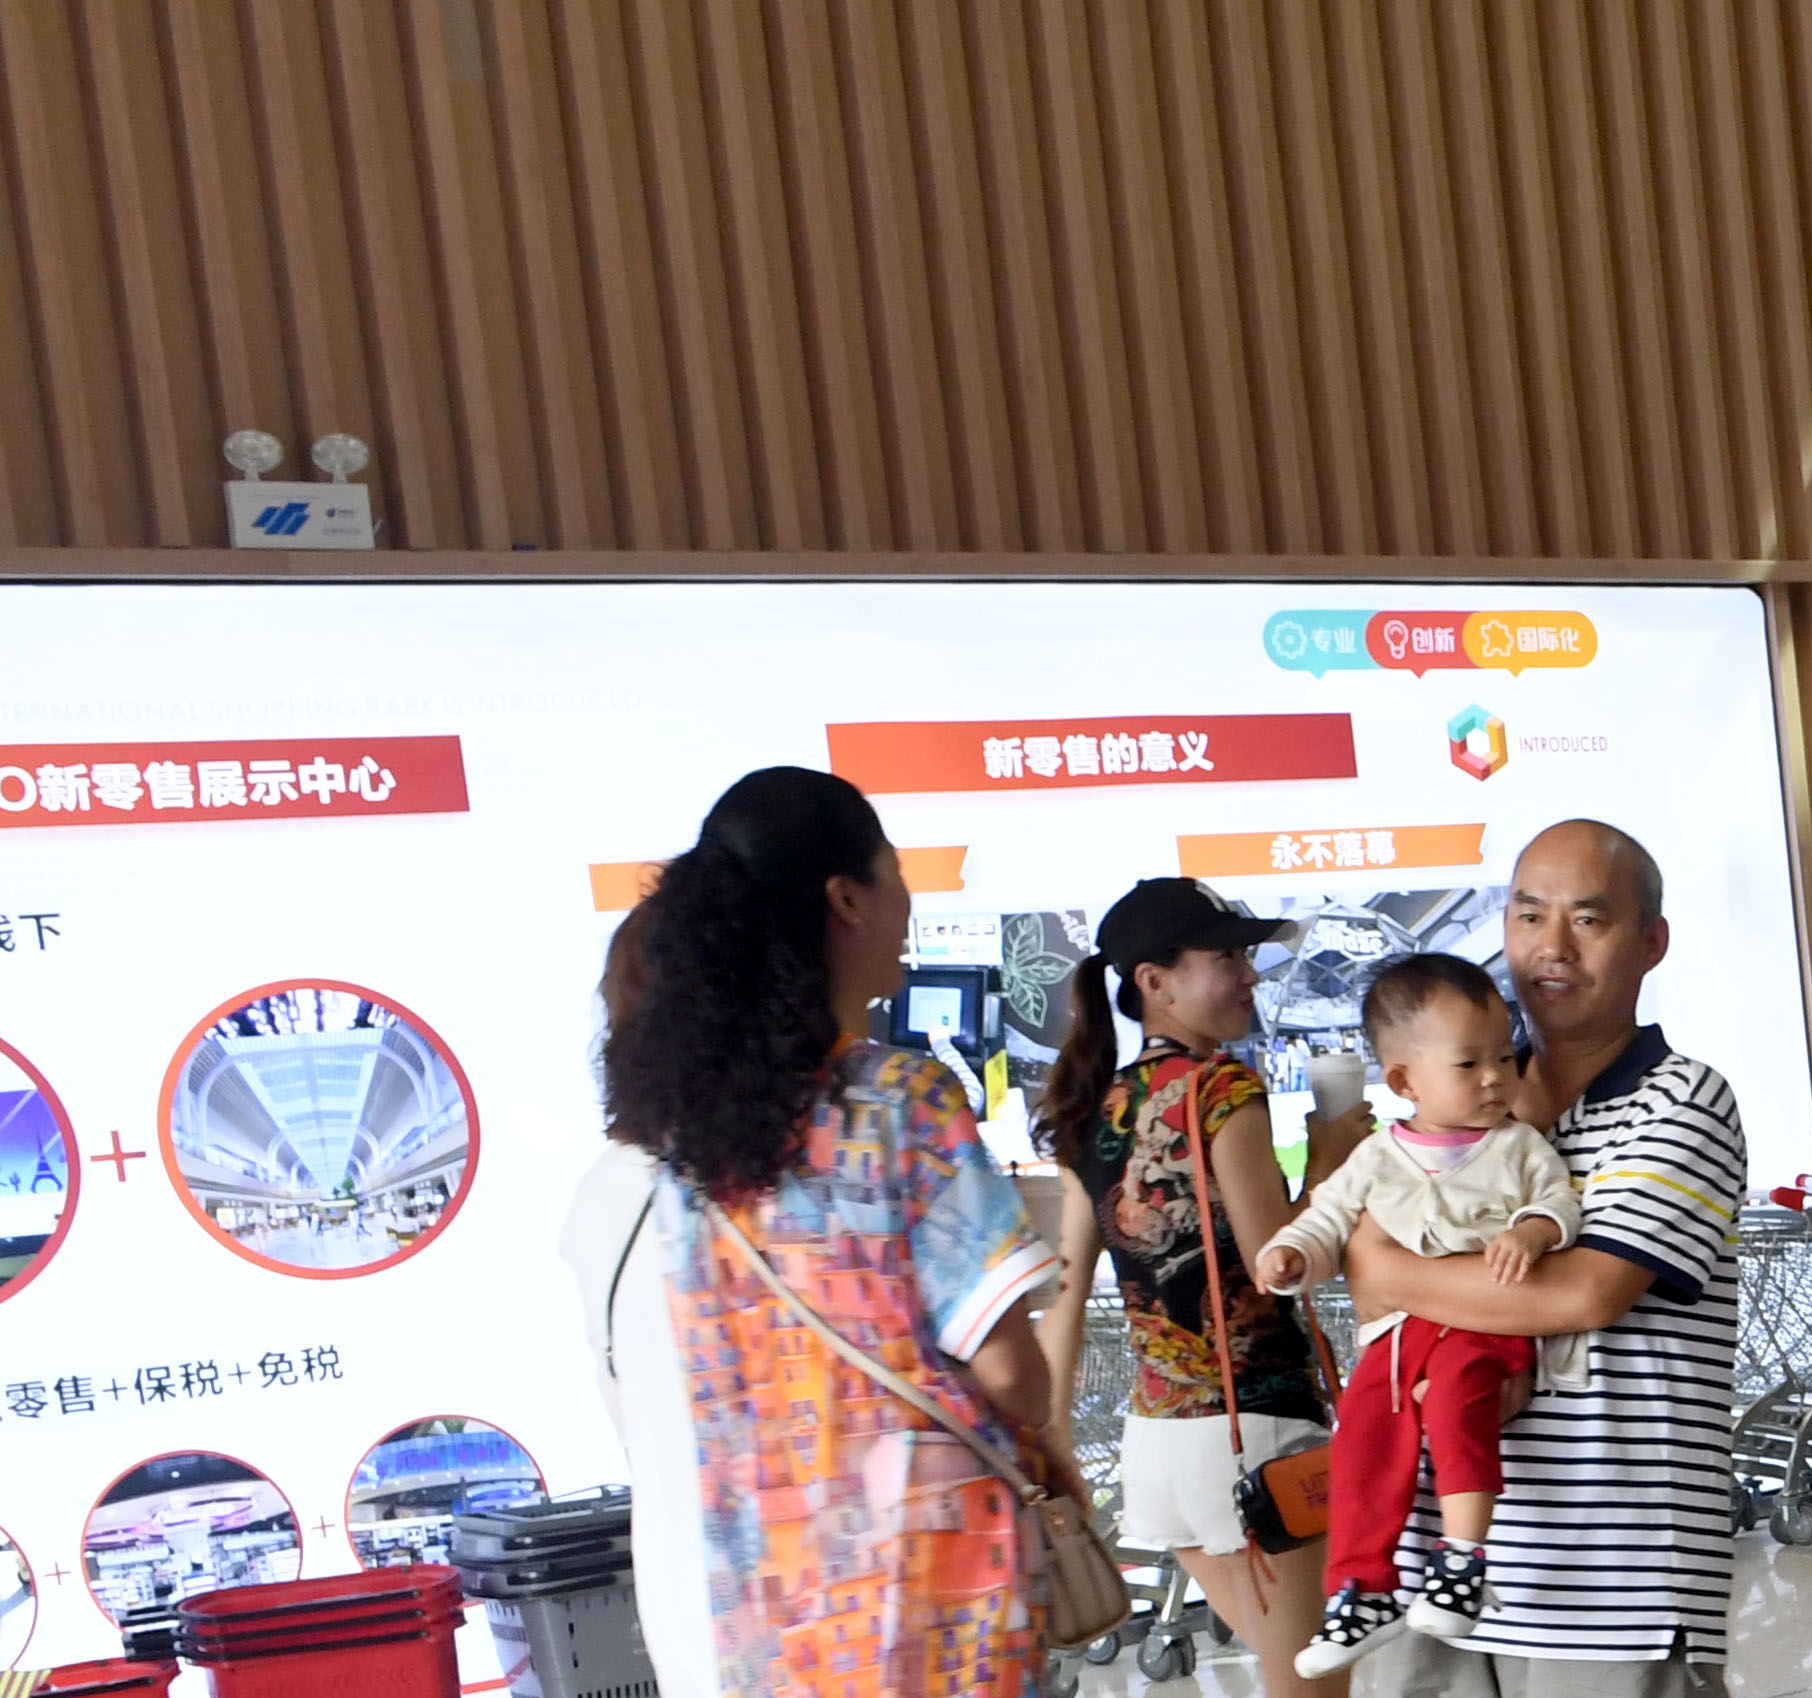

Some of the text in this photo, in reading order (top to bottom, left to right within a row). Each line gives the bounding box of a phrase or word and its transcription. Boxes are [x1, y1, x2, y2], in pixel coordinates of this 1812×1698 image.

[1311, 627, 1356, 654] 专业
[1411, 626, 1456, 654] 创新
[1516, 626, 1581, 653] 国际化
[982, 730, 1215, 778] 新零售的意义
[1519, 735, 1608, 753] INTRODUCED
[1270, 830, 1397, 870] 永不落幕
